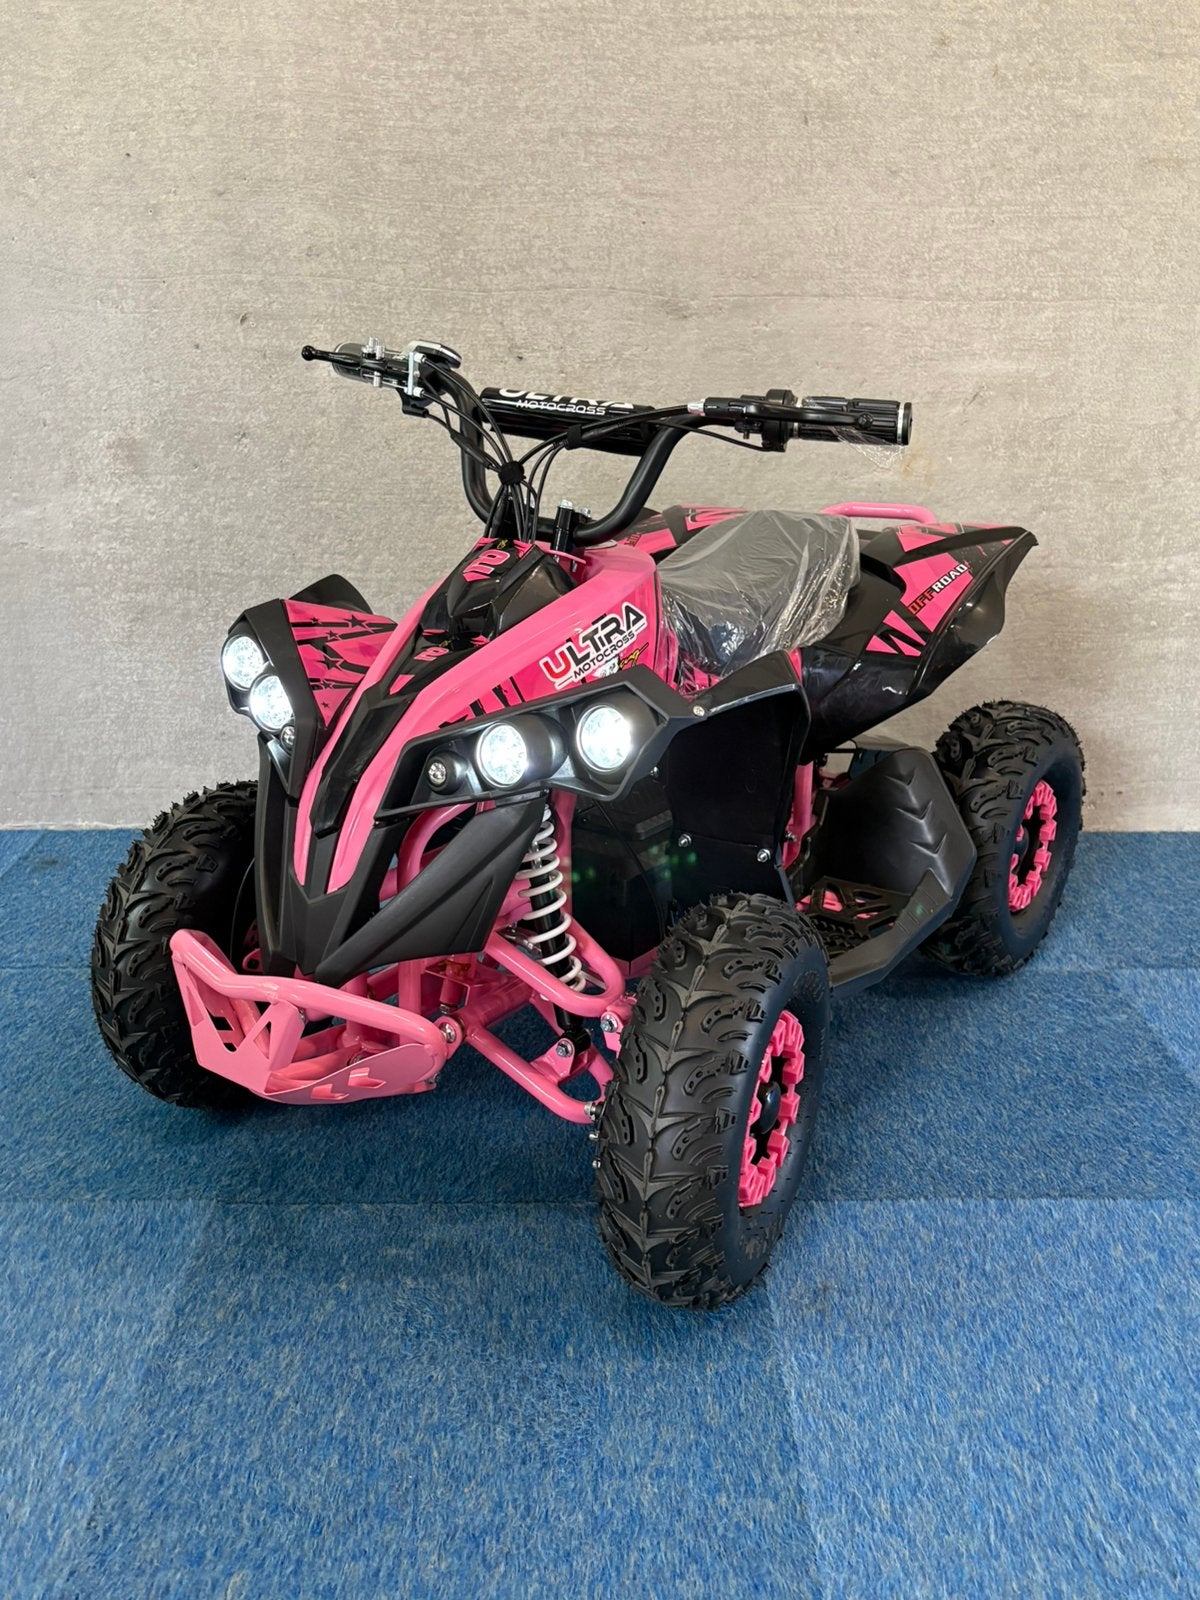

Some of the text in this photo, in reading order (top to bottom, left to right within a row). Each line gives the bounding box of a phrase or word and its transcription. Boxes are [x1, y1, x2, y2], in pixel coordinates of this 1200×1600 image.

[516, 400, 606, 416] MOTOCROSS
[542, 603, 645, 680] ULTRA
[573, 631, 635, 679] MOTOCROSS
